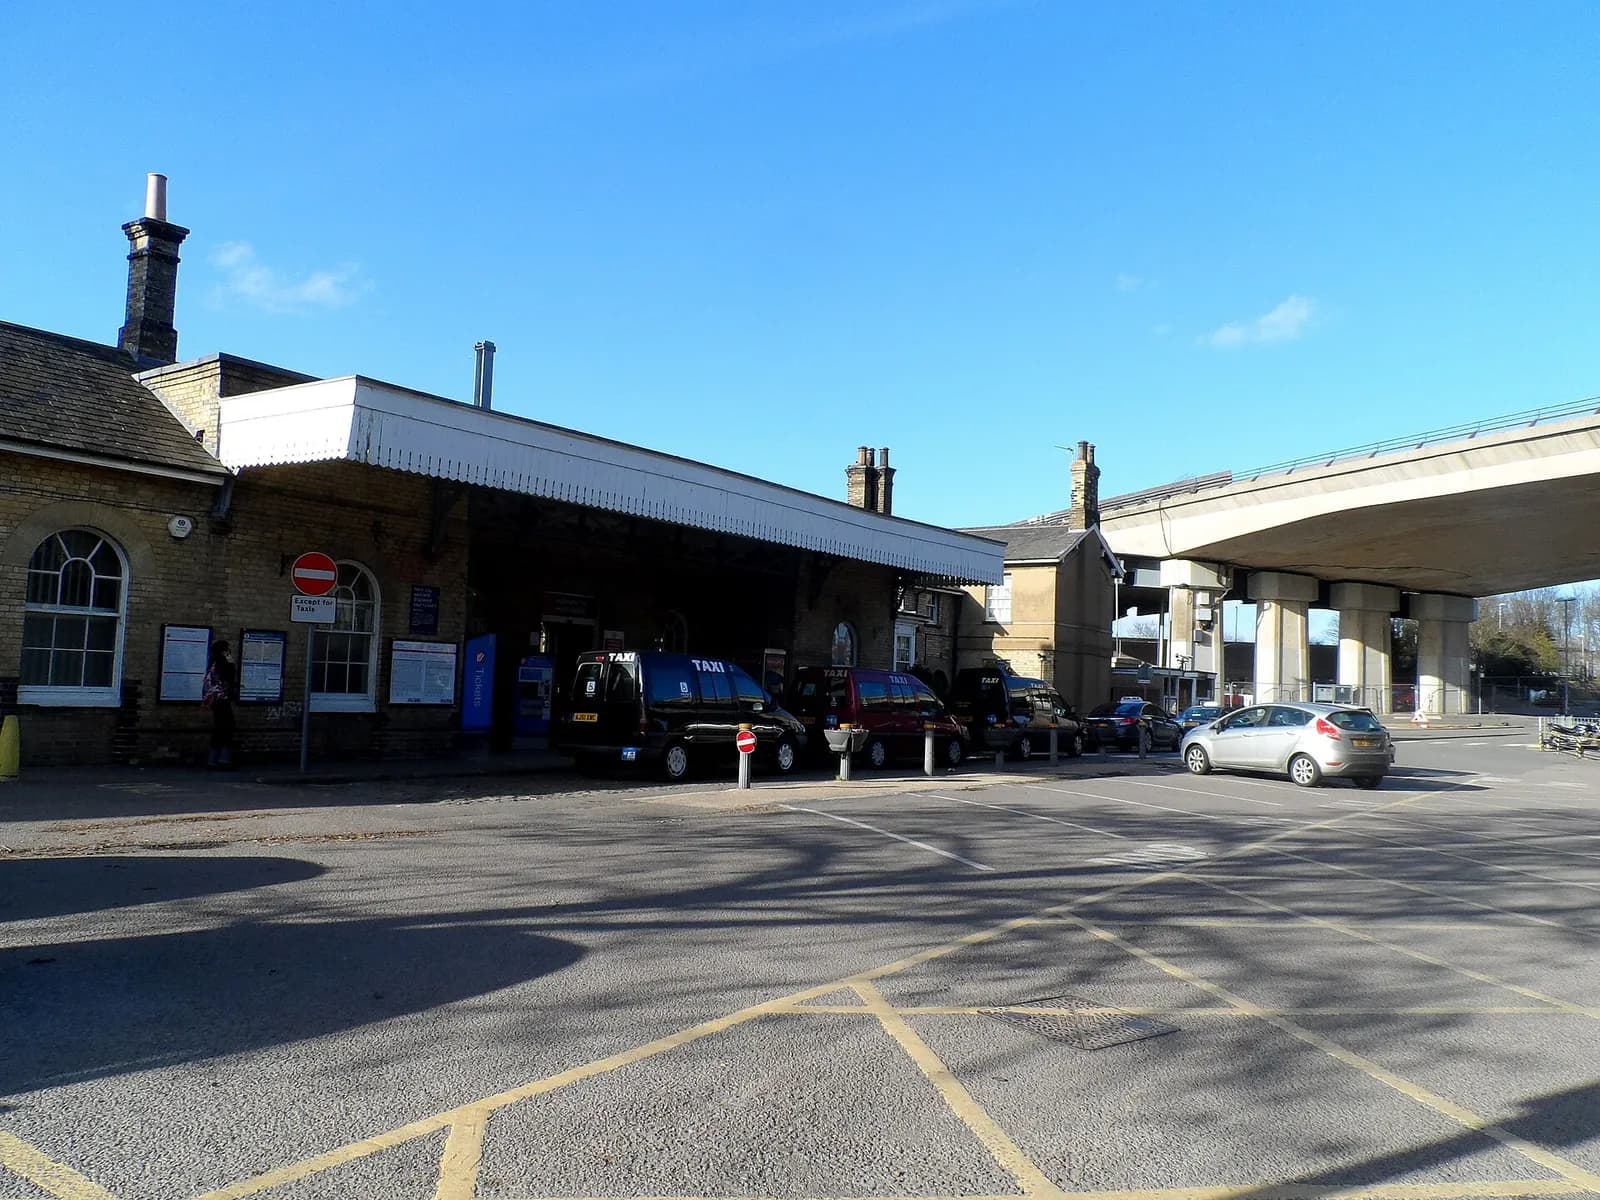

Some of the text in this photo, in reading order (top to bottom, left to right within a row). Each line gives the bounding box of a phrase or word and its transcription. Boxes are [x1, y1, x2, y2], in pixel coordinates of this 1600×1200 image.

[608, 652, 636, 662] TAXI
[691, 659, 725, 673] TAXI
[823, 669, 848, 678] TAXI
[888, 675, 908, 684] TAXI
[472, 666, 484, 708] Tickets
